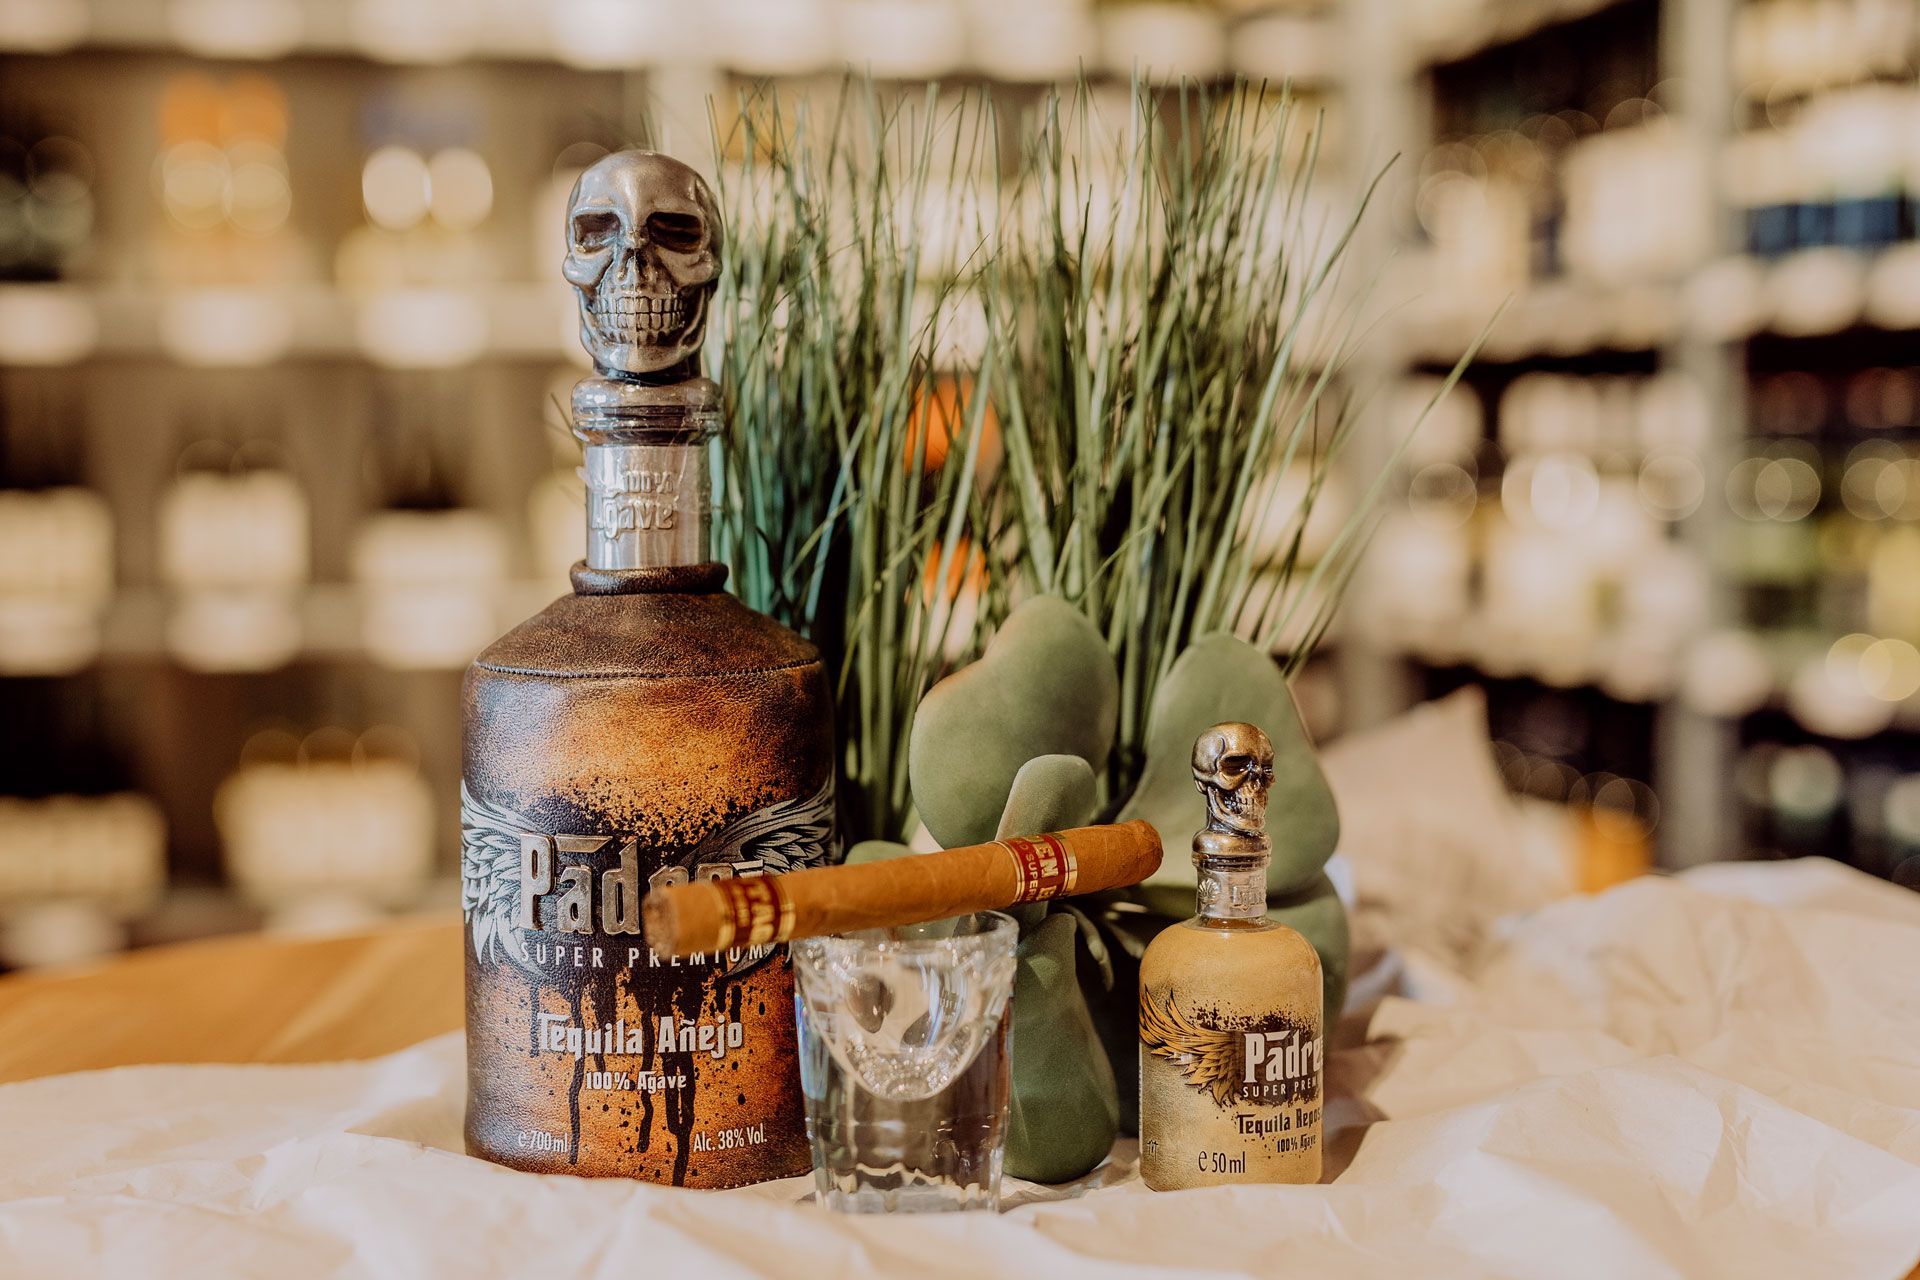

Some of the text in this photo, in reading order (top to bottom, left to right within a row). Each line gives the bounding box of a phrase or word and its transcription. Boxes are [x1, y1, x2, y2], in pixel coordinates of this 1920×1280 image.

[521, 942, 603, 968] SUPER
[536, 1012, 743, 1062] Tequila Añejo
[1243, 1029, 1323, 1084] Padre
[586, 1070, 687, 1095] 100% Agave
[1243, 1083, 1286, 1098] SUPER
[1236, 1111, 1291, 1138] Tequila
[693, 1123, 768, 1153] Alc. 38% Vol.
[1277, 1136, 1298, 1153] 100%
